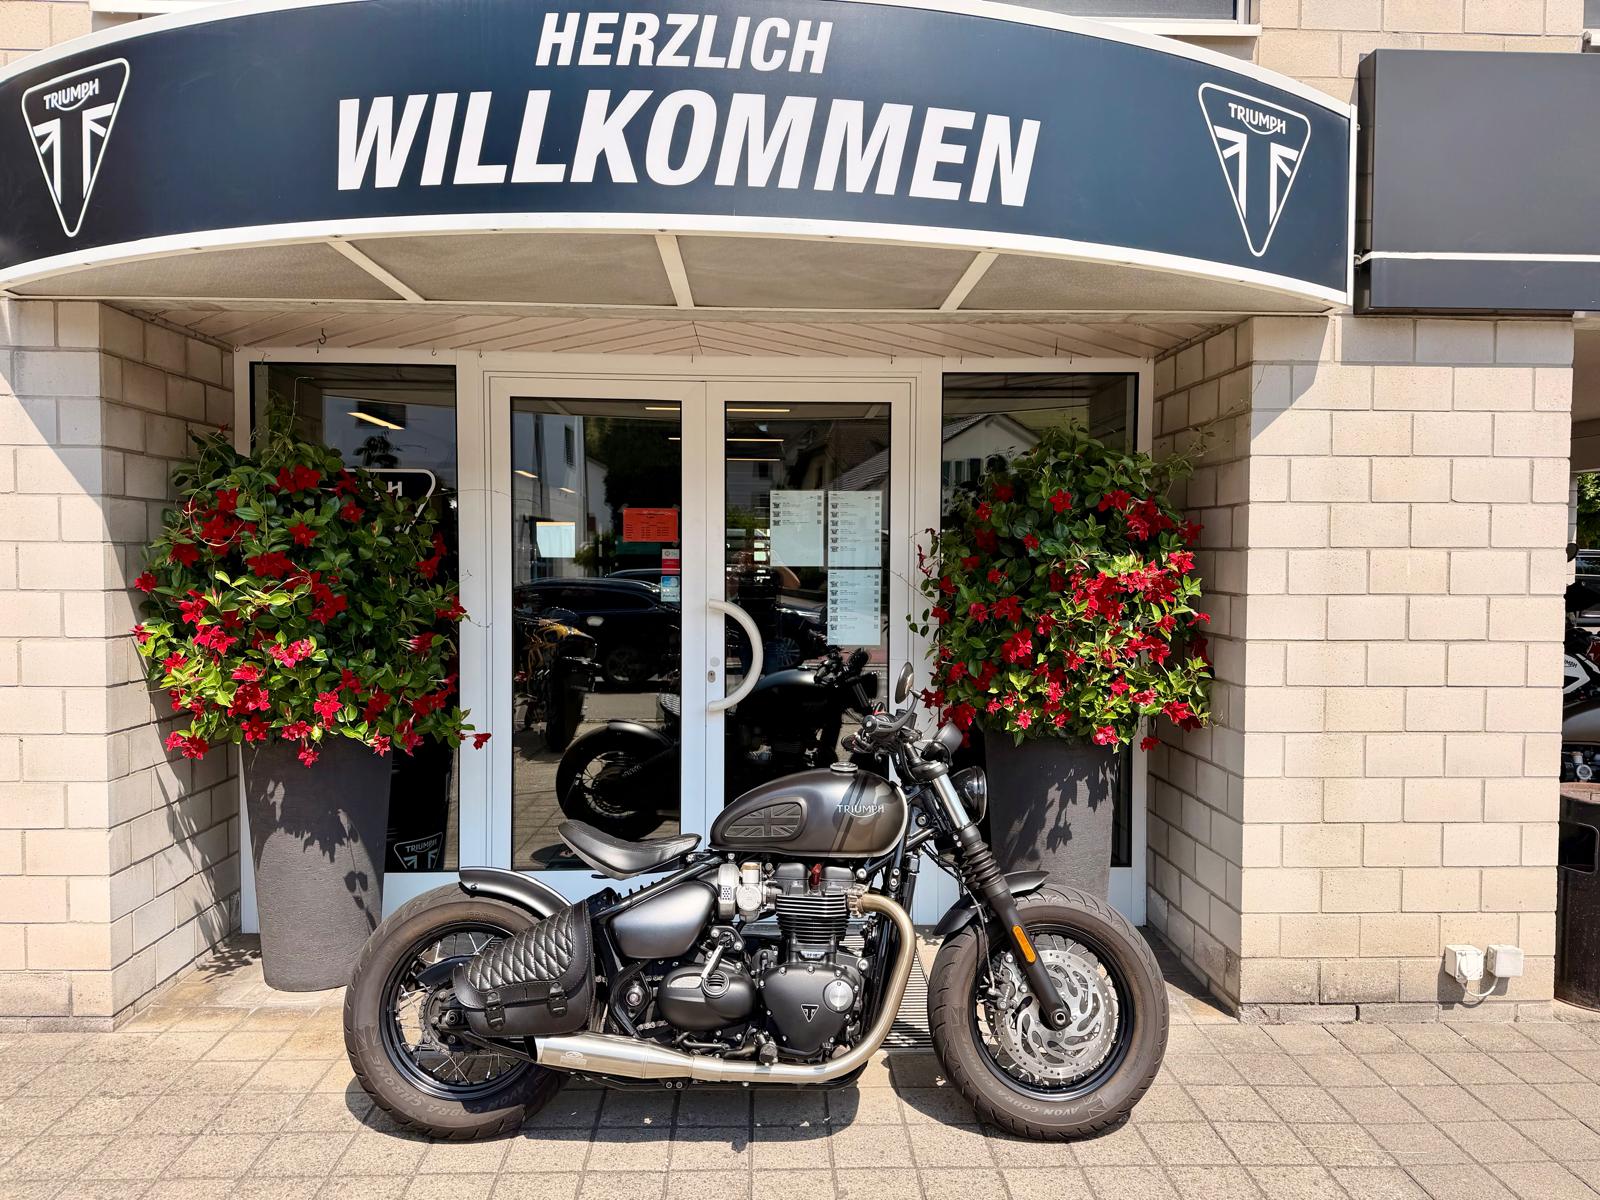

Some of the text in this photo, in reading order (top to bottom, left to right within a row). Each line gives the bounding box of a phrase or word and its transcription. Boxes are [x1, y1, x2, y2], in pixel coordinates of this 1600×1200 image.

[536, 13, 833, 74] HERZLICH
[43, 78, 99, 111] TRIUMPH
[1228, 102, 1286, 135] TRIUMPH
[338, 90, 1040, 207] WILLKOMMEN
[837, 802, 885, 817] TRIUMPH
[405, 838, 438, 853] TRIUMPH
[1043, 1105, 1081, 1117] AVON
